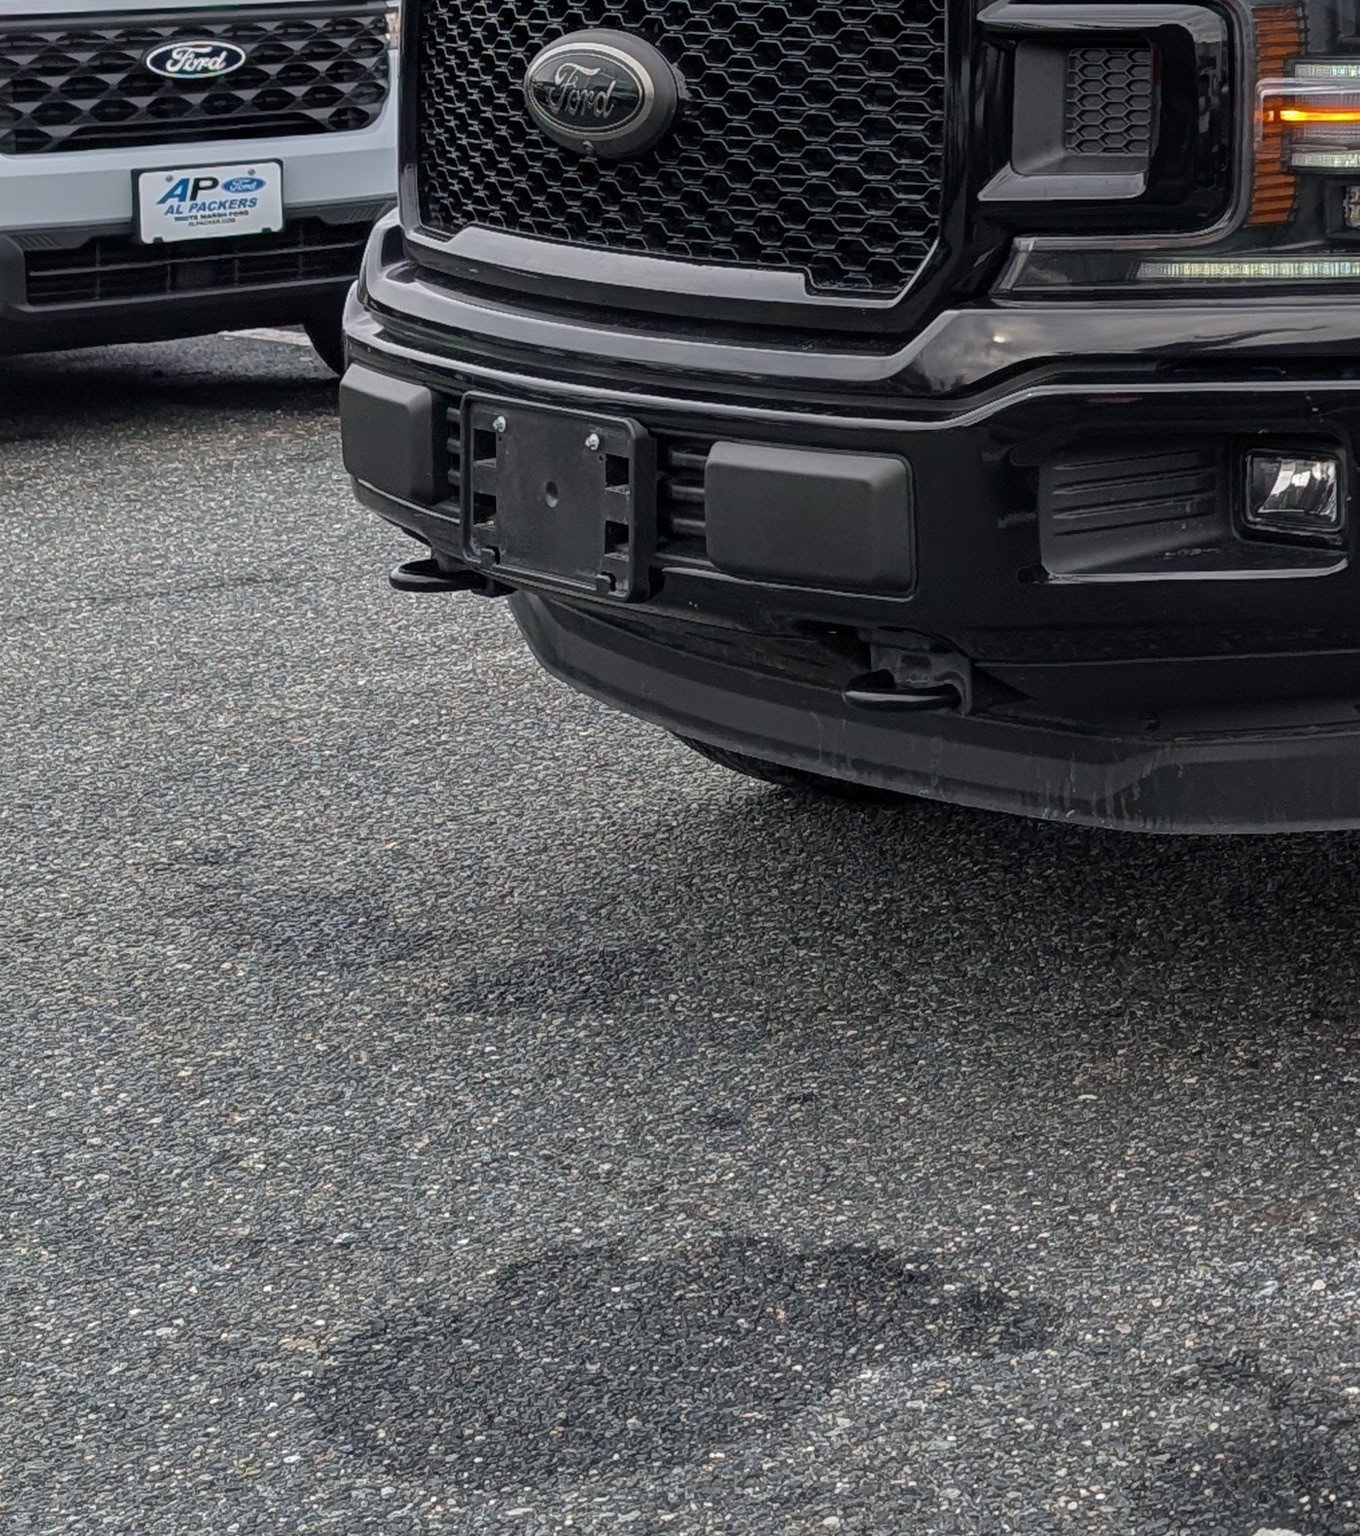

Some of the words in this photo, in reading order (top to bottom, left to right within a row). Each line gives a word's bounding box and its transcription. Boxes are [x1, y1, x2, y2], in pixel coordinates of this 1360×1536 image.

[165, 46, 228, 72] Ford
[547, 62, 617, 119] Ford
[156, 176, 220, 205] AP
[164, 204, 184, 216] AL
[188, 197, 258, 214] PACKERS
